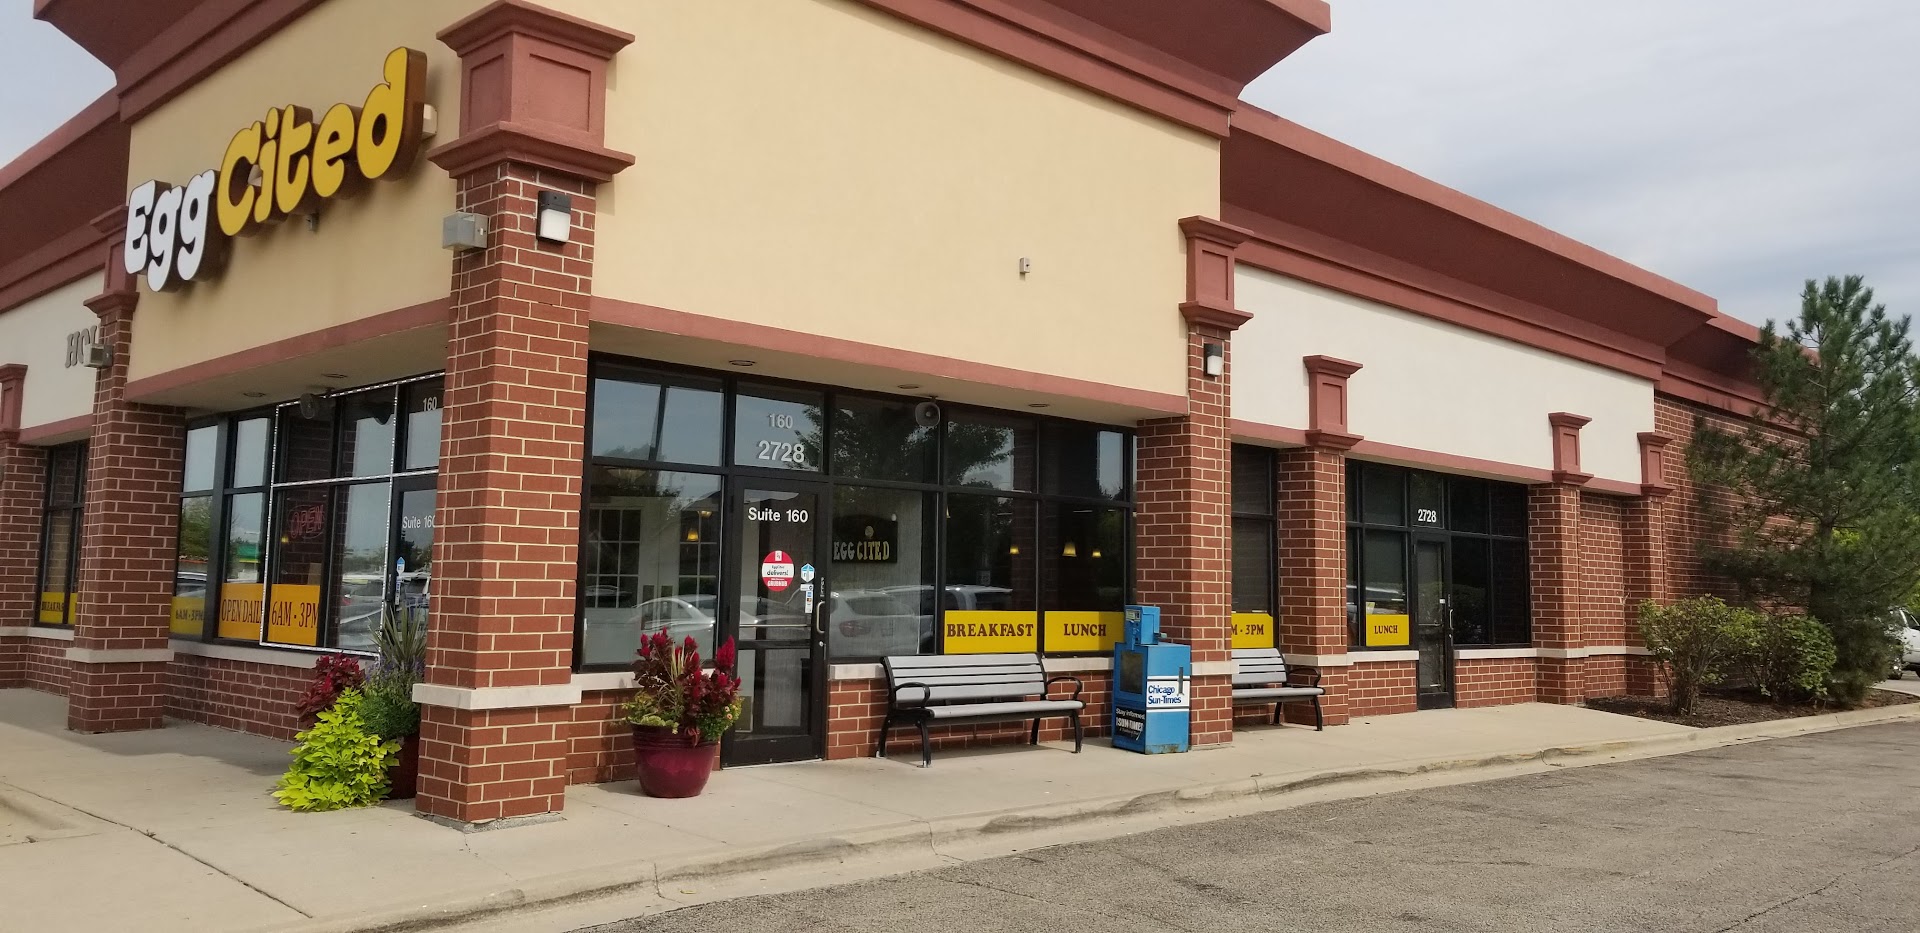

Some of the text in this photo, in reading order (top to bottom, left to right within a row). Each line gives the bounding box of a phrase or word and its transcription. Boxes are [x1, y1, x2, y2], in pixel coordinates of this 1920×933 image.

[423, 396, 438, 412] 160
[768, 413, 794, 429] 160
[758, 439, 805, 463] 2728
[291, 505, 324, 538] OPEN
[402, 515, 421, 529] Suite
[747, 506, 808, 523] Suite 160
[1417, 508, 1437, 523] 2728
[221, 599, 241, 622] OPEN
[271, 601, 292, 627] 6AM
[946, 623, 1034, 637] BREAKFAST
[1063, 623, 1107, 637] LUNCH
[1245, 624, 1264, 635] 3PM
[1374, 625, 1398, 634] LUNCH
[1147, 685, 1176, 695] Chicago
[1147, 695, 1182, 704] Sun-Times
